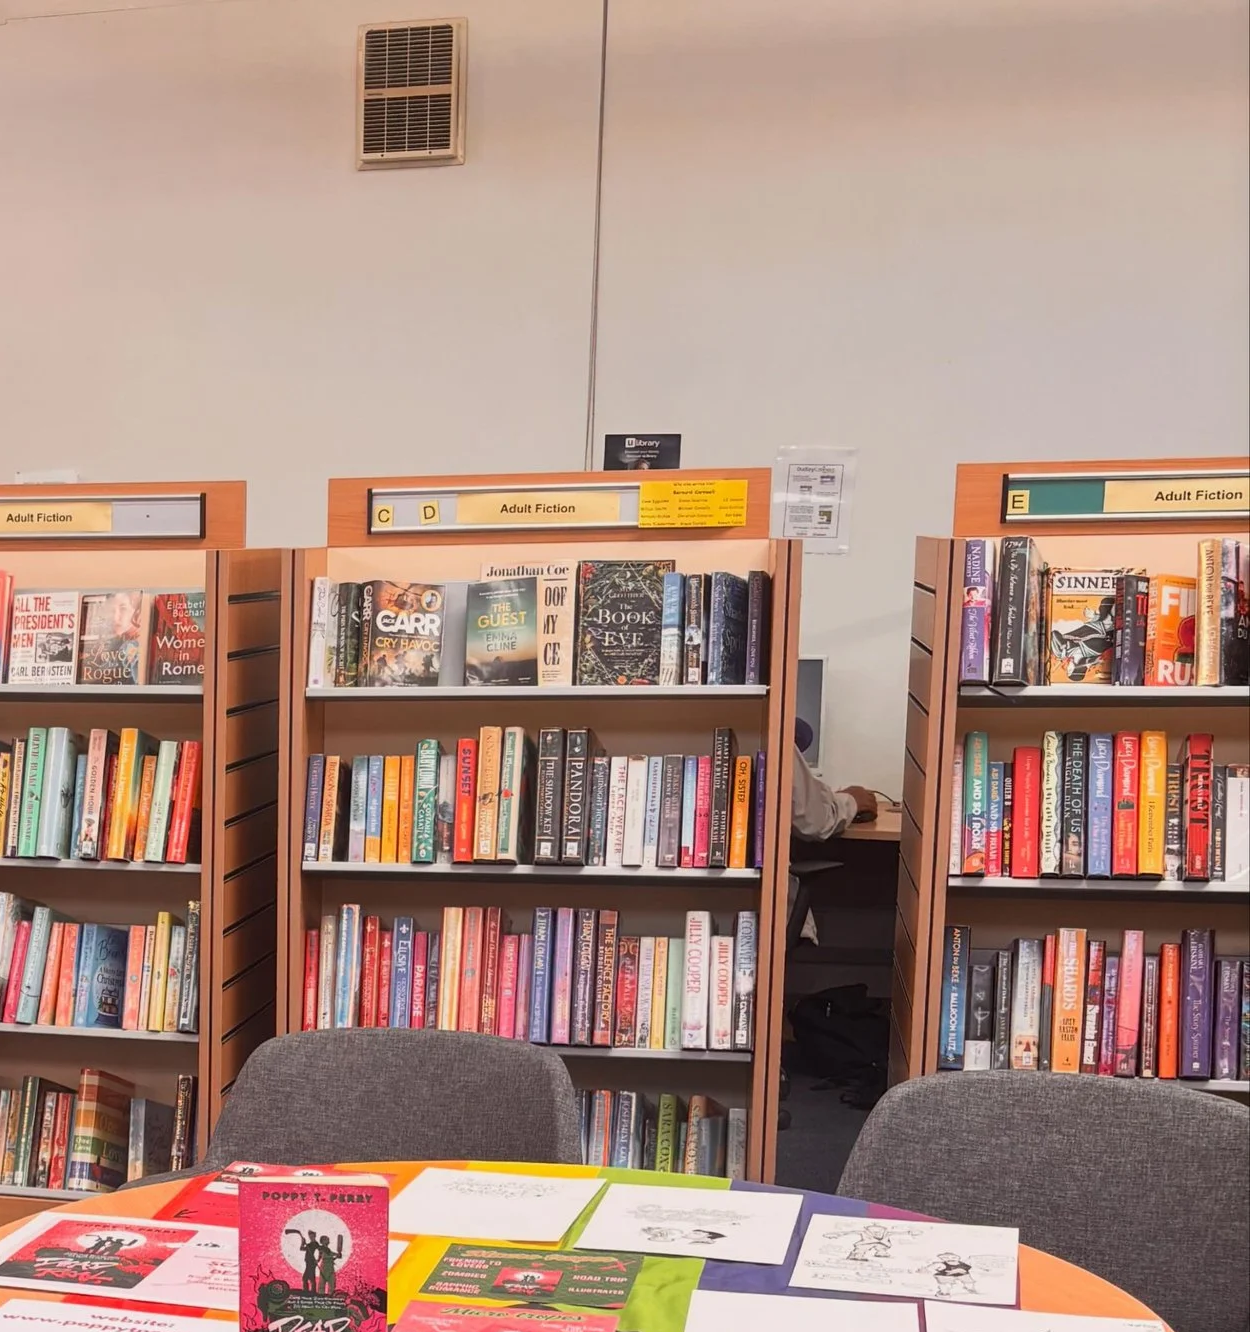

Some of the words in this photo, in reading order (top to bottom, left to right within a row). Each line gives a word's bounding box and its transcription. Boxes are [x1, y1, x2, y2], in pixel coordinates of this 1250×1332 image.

[1012, 495, 1024, 509] E
[1155, 491, 1192, 501] Adult
[1196, 490, 1242, 500] Fiction
[378, 509, 390, 523] C
[423, 505, 436, 519] D
[500, 504, 531, 514] Adult
[535, 504, 575, 513] Fiction
[6, 513, 34, 523] Adult
[37, 513, 72, 522] Fiction
[486, 566, 544, 577] Jonathan
[547, 565, 569, 576] Coe
[971, 546, 981, 583] NADINE
[15, 598, 30, 612] ALL
[33, 597, 51, 611] THE
[362, 585, 372, 621] CARR
[492, 603, 511, 612] THE
[14, 614, 75, 630] PRESIDENT'S
[376, 610, 441, 636] CARR
[478, 612, 526, 628] GUEST
[598, 610, 653, 625] BOOK
[174, 623, 199, 633] Two
[13, 633, 33, 648] MEN
[375, 638, 397, 649] CRY
[402, 641, 439, 652] HAVOC
[486, 633, 517, 642] EMMA
[604, 632, 644, 646] EVE
[487, 642, 517, 652] CLINE
[179, 652, 189, 660] in
[11, 667, 29, 677] CARL
[31, 665, 72, 677] BERNSTEIN
[83, 666, 130, 683] Rogue
[162, 664, 205, 676] Rome
[1073, 738, 1082, 756] THE
[1093, 738, 1110, 759] Lucy
[1118, 737, 1136, 756] Lucy
[461, 748, 472, 796] SUNSET
[545, 761, 554, 779] THE
[1072, 760, 1082, 794] DEATH
[1121, 759, 1135, 796] Diamond
[1095, 761, 1109, 798] Diamond
[737, 779, 746, 803] SISTER
[973, 778, 981, 800] AND
[1190, 750, 1210, 830] TRUST
[545, 780, 554, 815] SHADOW
[568, 761, 583, 835] PANDORA
[972, 801, 980, 815] SO
[1072, 799, 1081, 814] OF
[543, 818, 551, 835] KEY
[1071, 818, 1081, 833] US
[972, 822, 981, 849] ROAR
[952, 928, 960, 957] ANTON
[718, 942, 729, 966] JILLY
[603, 946, 612, 981] SILENCE
[687, 949, 702, 994] COOPER
[413, 965, 424, 1017] PARADISE
[718, 968, 728, 1006] COOPER
[1063, 958, 1079, 1010] SHARDS
[601, 983, 610, 1021] FACTORY
[262, 1191, 308, 1201] POPPY
[573, 1274, 603, 1282] ROAD
[90, 1312, 175, 1328] website:
